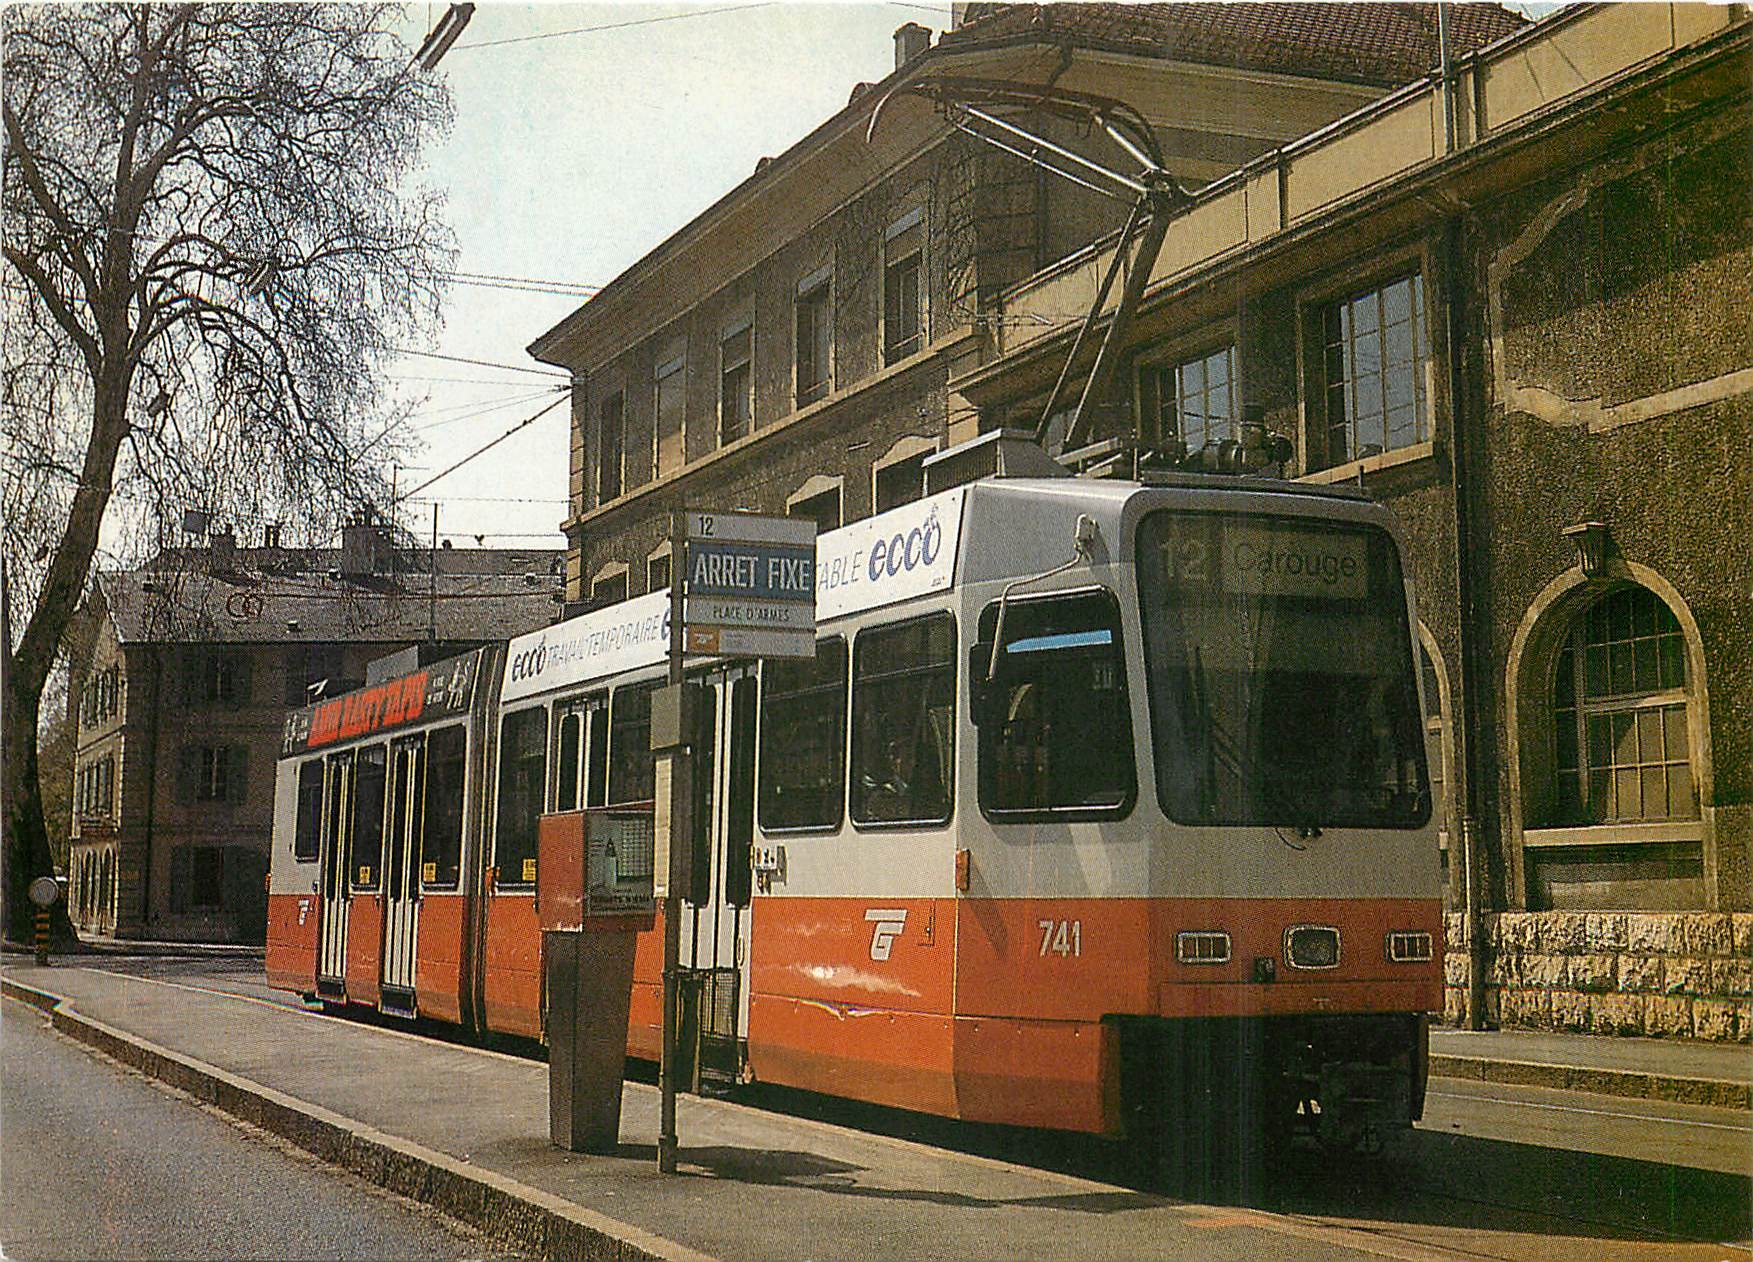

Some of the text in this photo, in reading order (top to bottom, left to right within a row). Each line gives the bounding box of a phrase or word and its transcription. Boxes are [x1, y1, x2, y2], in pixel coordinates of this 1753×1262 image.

[699, 516, 714, 536] 12
[693, 553, 811, 591] ARRET FIXE
[818, 550, 862, 591] ABLE
[1160, 540, 1358, 585] 12 Carouge
[713, 606, 741, 620] PLACE
[585, 616, 661, 656] TEMPORAIRE
[1039, 920, 1081, 958] 741
